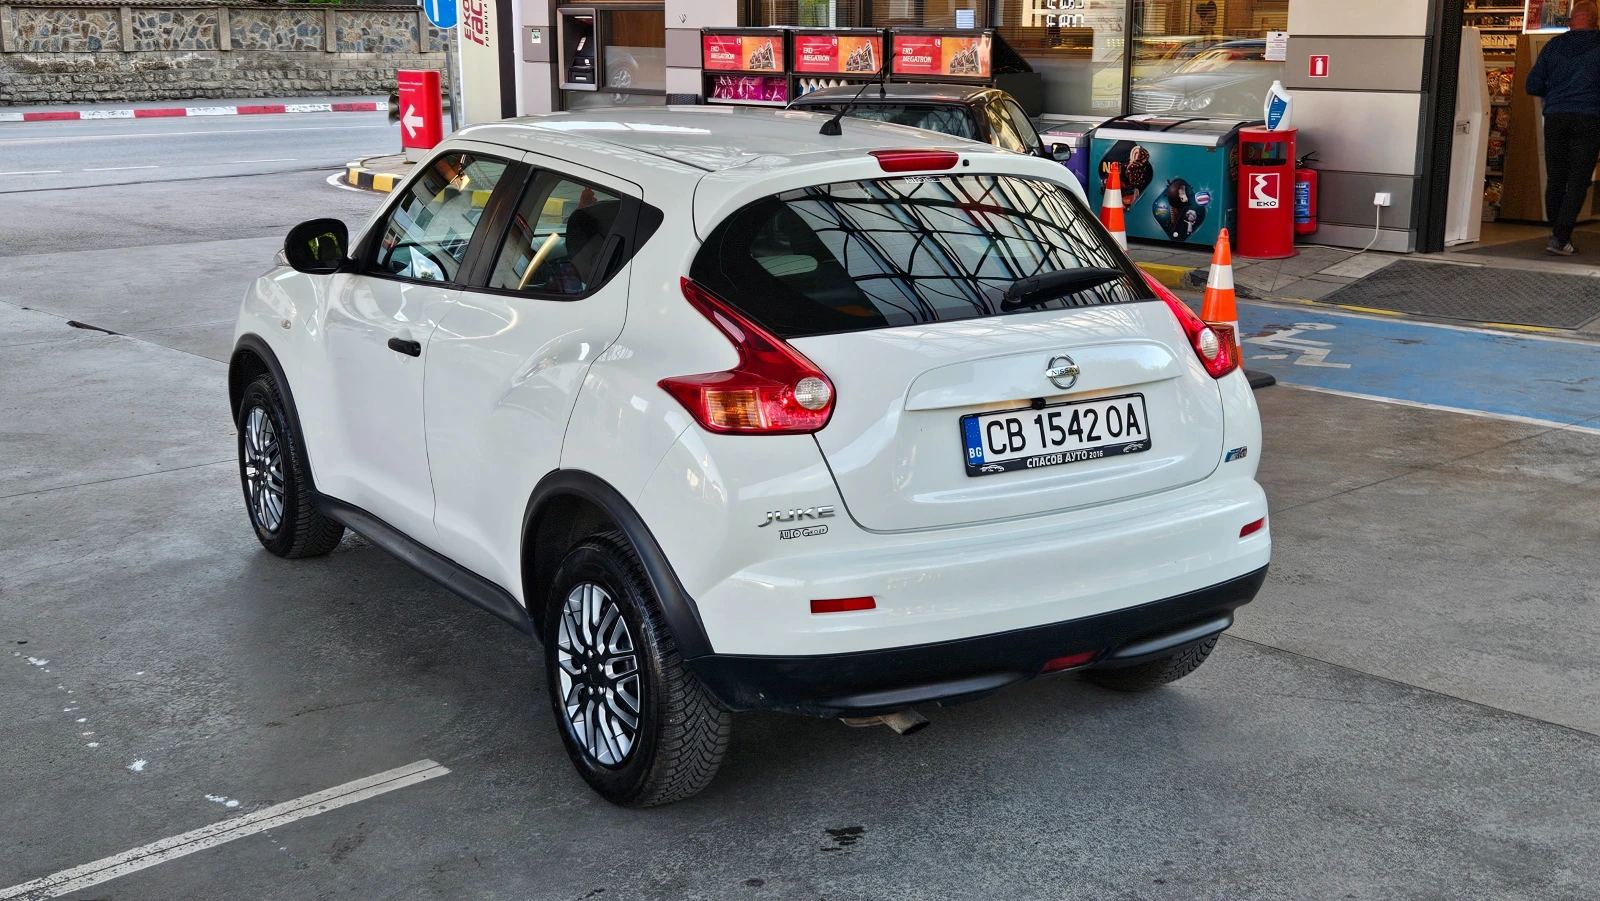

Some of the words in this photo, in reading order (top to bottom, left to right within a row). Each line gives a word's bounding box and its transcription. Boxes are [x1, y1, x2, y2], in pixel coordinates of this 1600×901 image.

[463, 0, 472, 40] EKO
[471, 0, 484, 46] rac
[902, 55, 932, 63] MEGATRON
[1052, 366, 1078, 375] NISSAN
[986, 417, 1026, 455] CB
[1033, 408, 1102, 449] 1542
[1105, 402, 1142, 438] OA
[969, 446, 983, 459] BG
[1026, 455, 1064, 468] СПАСОВ
[1065, 450, 1088, 462] АУТО
[1089, 450, 1104, 459] 2016
[757, 504, 836, 528] JUKE
